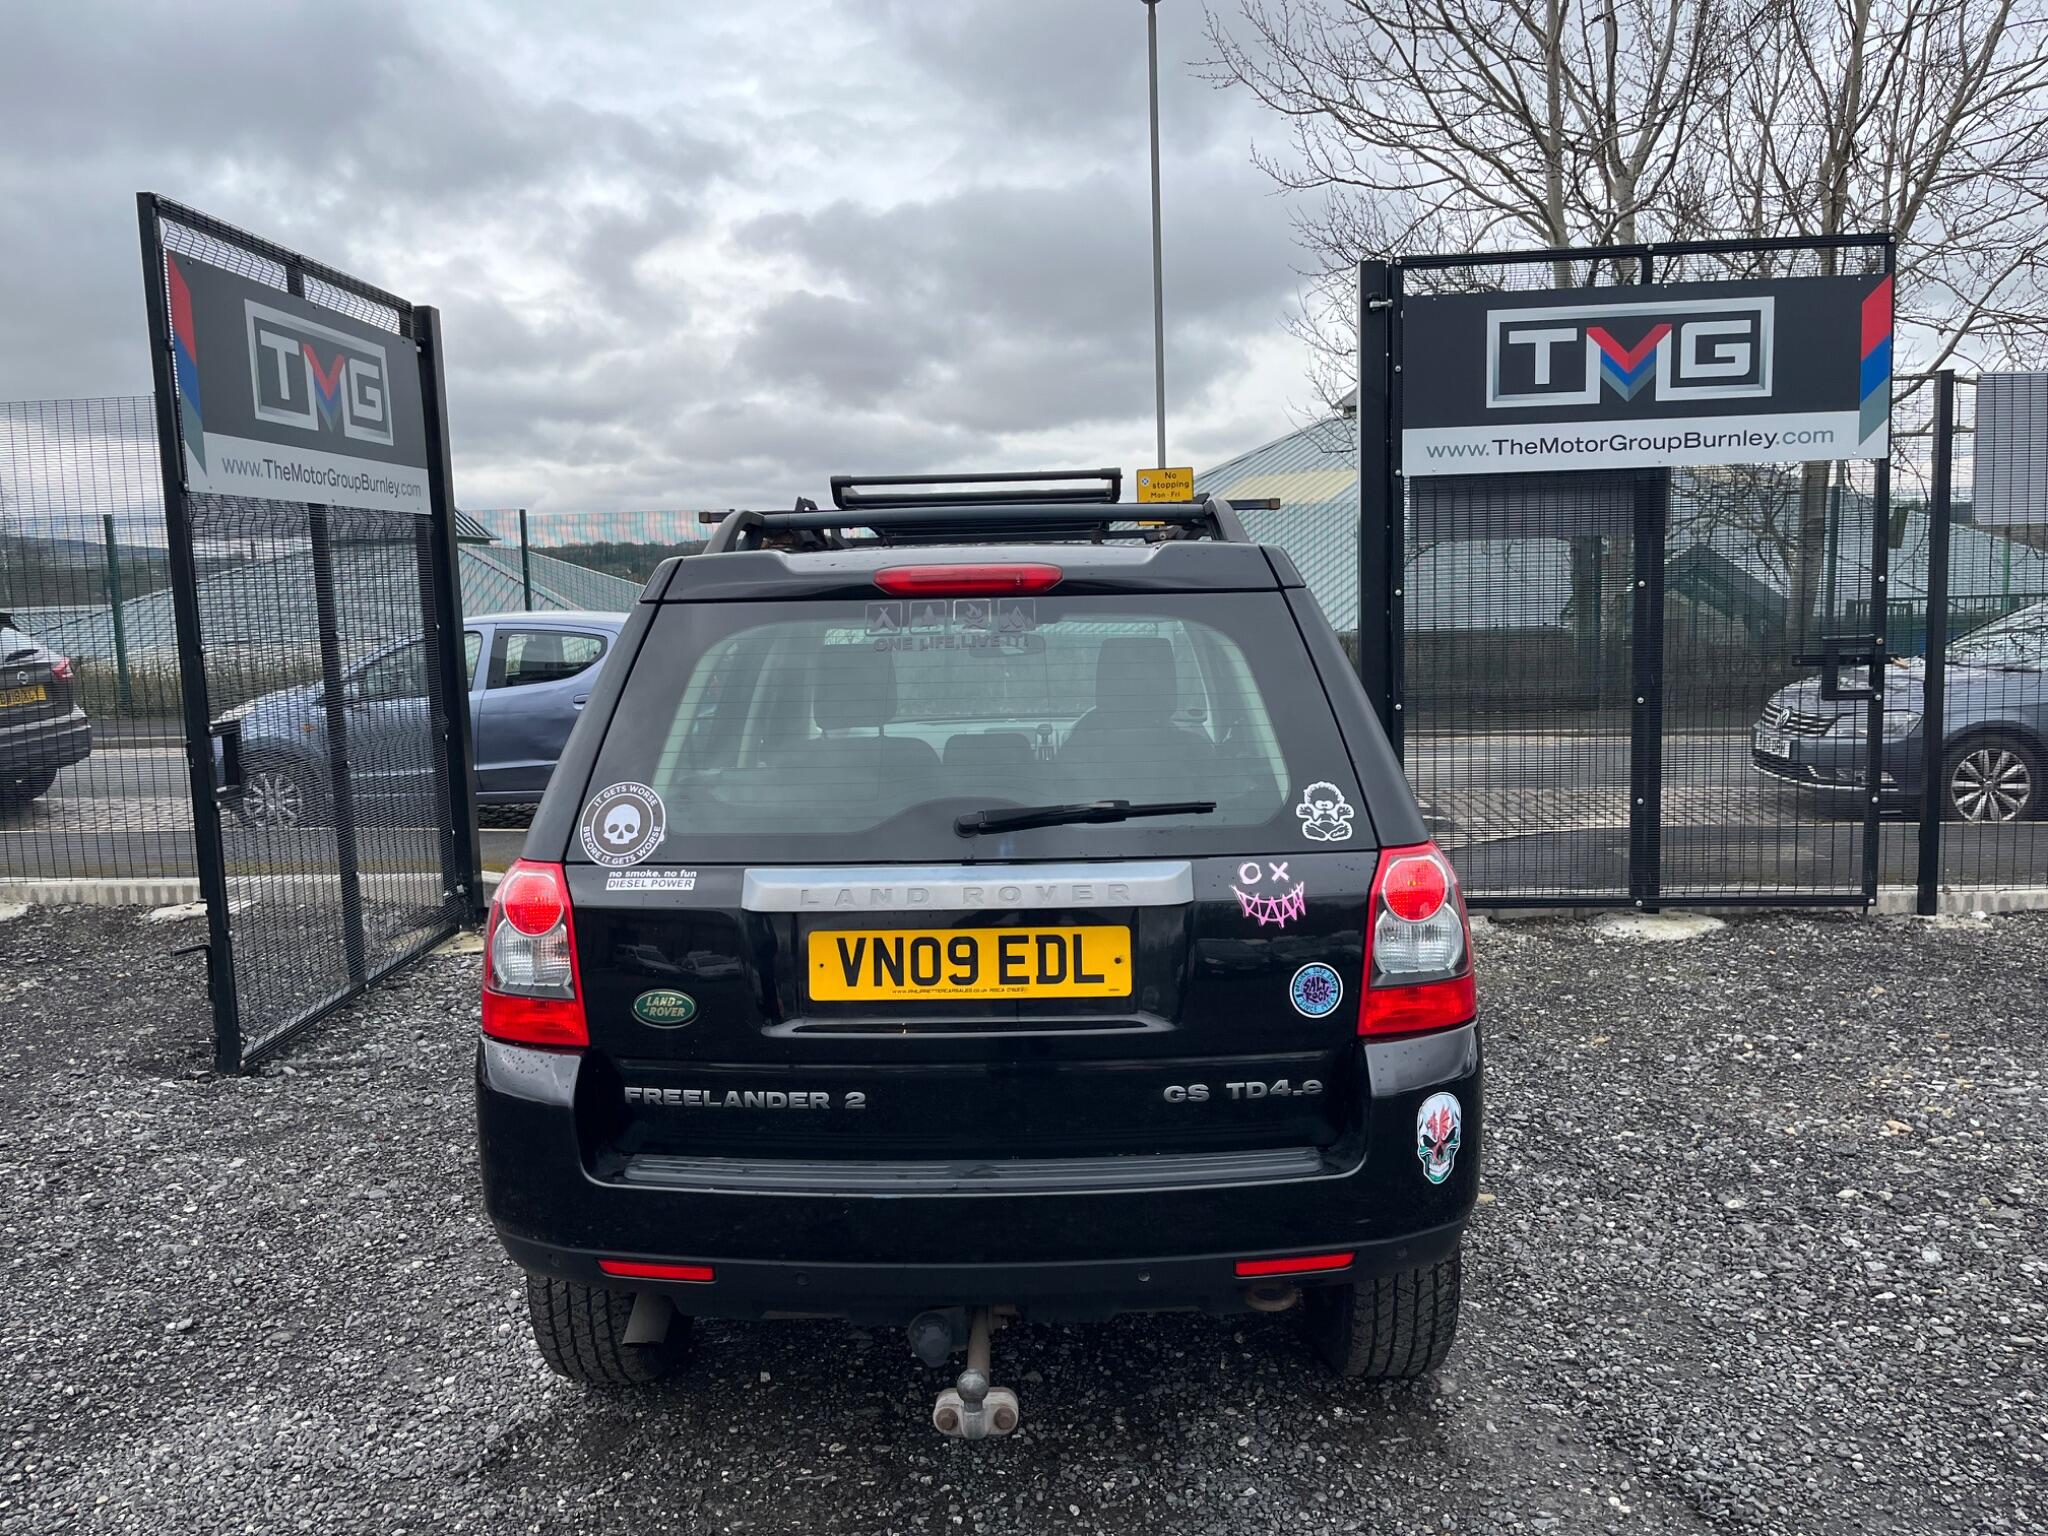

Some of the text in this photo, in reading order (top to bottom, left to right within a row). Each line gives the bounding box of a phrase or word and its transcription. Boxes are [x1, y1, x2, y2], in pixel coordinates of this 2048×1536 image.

[1508, 319, 1752, 403] TMG
[259, 329, 384, 433] TMG
[1426, 427, 1835, 459] www.TheMotorGroupBurnley.com
[221, 456, 422, 498] www.TheMotorGroupBurnley.com
[1152, 481, 1189, 489] stopping
[874, 637, 913, 651] ONE
[594, 785, 658, 807] IT GETS WORSE
[583, 826, 661, 865] BEFORE IT GETS WORSE
[608, 879, 692, 888] DIESEL POWER
[664, 870, 677, 878] no
[680, 869, 697, 878] fun
[800, 883, 1132, 906] LAND ROVER
[836, 933, 1105, 987] VN09 EDL
[646, 996, 676, 1006] LAND
[649, 1006, 685, 1017] ROVER
[624, 1086, 866, 1110] FREELANDER 2
[1163, 1084, 1210, 1103] GS
